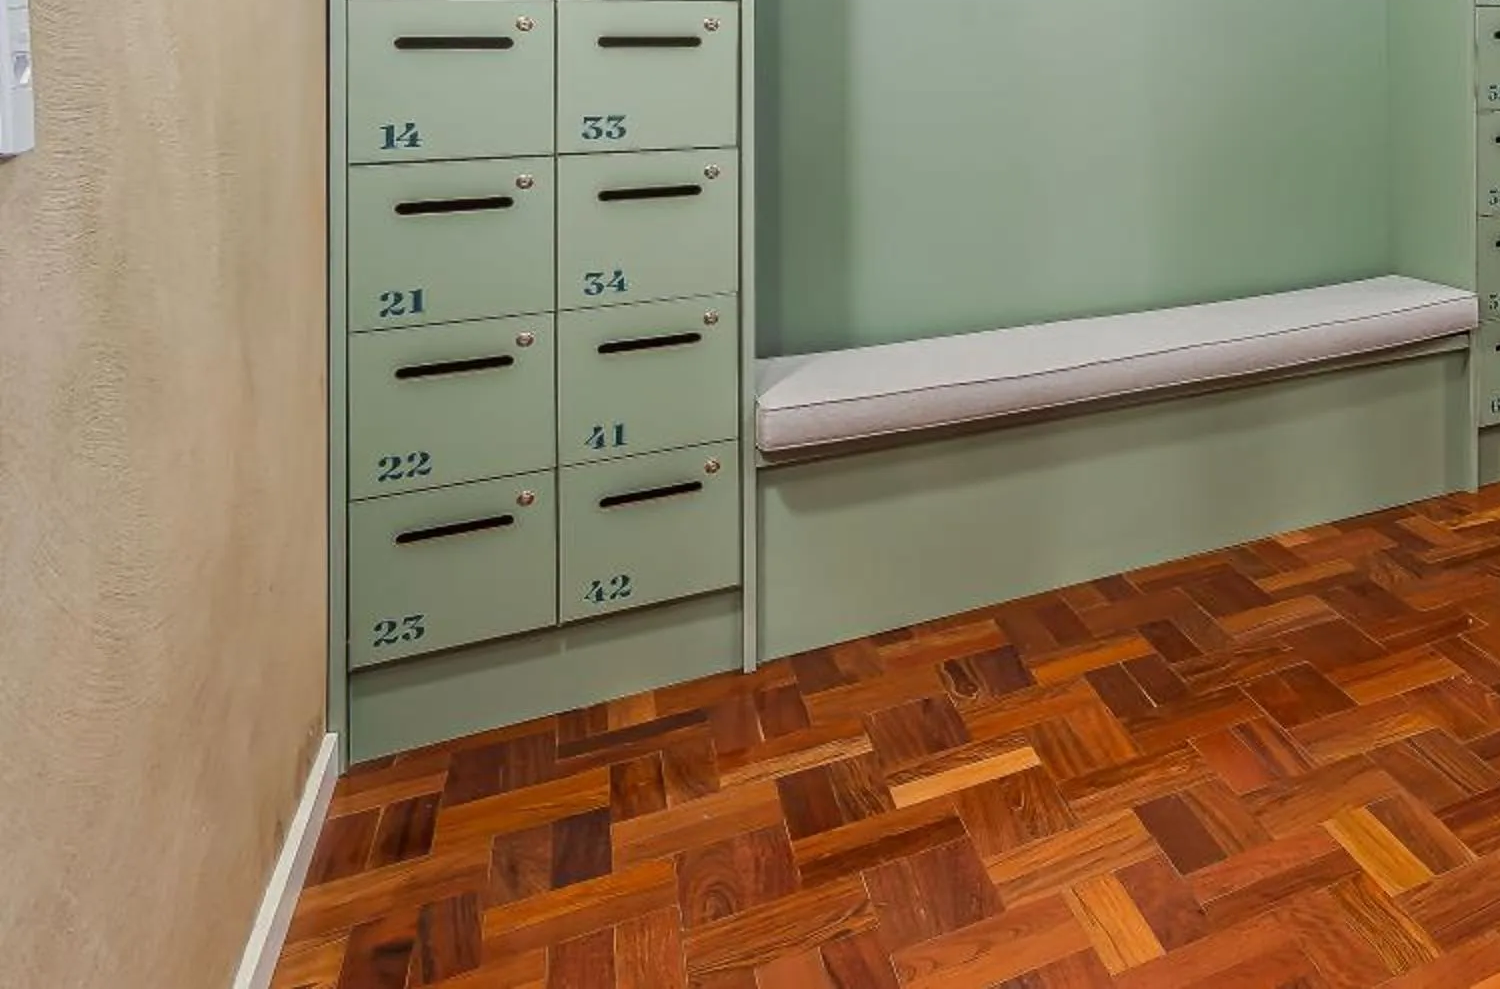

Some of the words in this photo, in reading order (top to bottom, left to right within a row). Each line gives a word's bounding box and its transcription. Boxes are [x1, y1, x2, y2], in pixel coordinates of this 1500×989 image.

[379, 122, 422, 150] 14
[581, 115, 628, 140] 33
[583, 269, 628, 297] 34
[379, 288, 425, 318] 21
[584, 423, 628, 450] 41
[378, 451, 432, 482] 22
[583, 574, 632, 603] 42
[373, 614, 425, 648] 23
